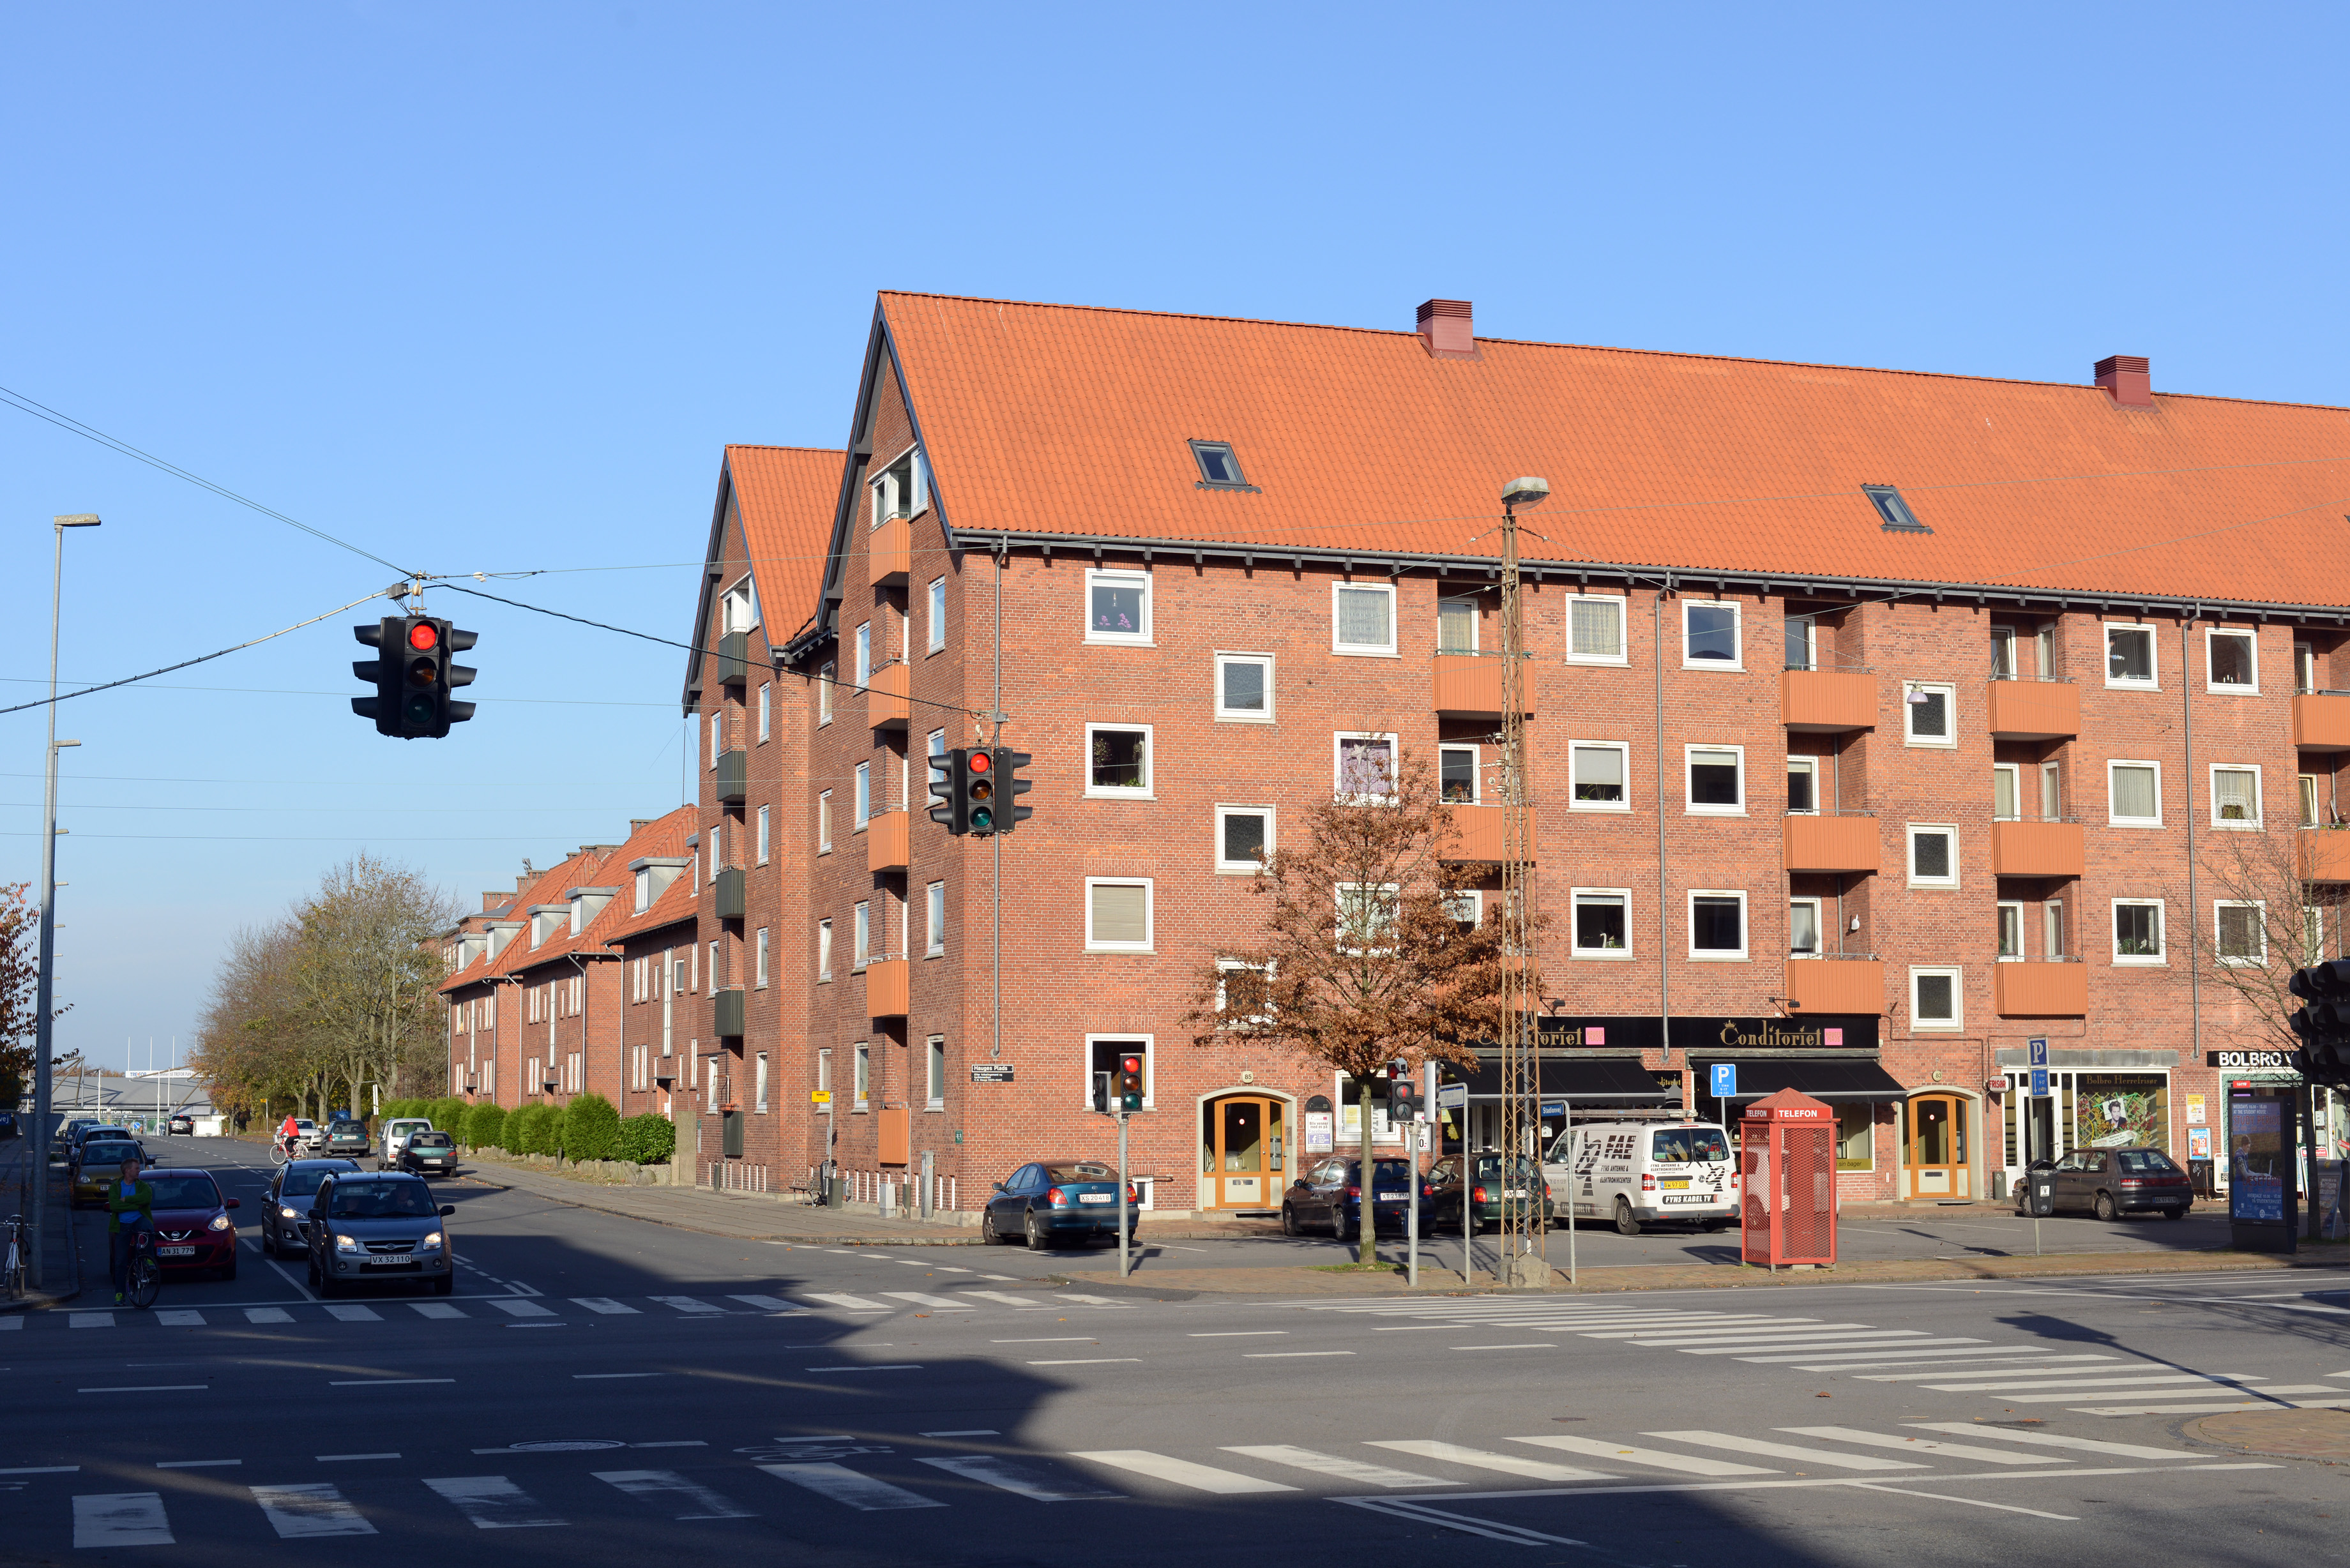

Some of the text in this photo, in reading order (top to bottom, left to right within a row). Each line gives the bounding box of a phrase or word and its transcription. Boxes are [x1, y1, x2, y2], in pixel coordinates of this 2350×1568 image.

[1720, 1020, 1821, 1045] Conditoriet
[2032, 1042, 2043, 1063] P
[2219, 1052, 2281, 1066] BOLBRO
[1718, 1067, 1729, 1083] P
[2086, 1075, 2157, 1084] Bolbro Herrefrisør
[1990, 1080, 2006, 1088] FRISØR
[2233, 1115, 2254, 1125] STUDY
